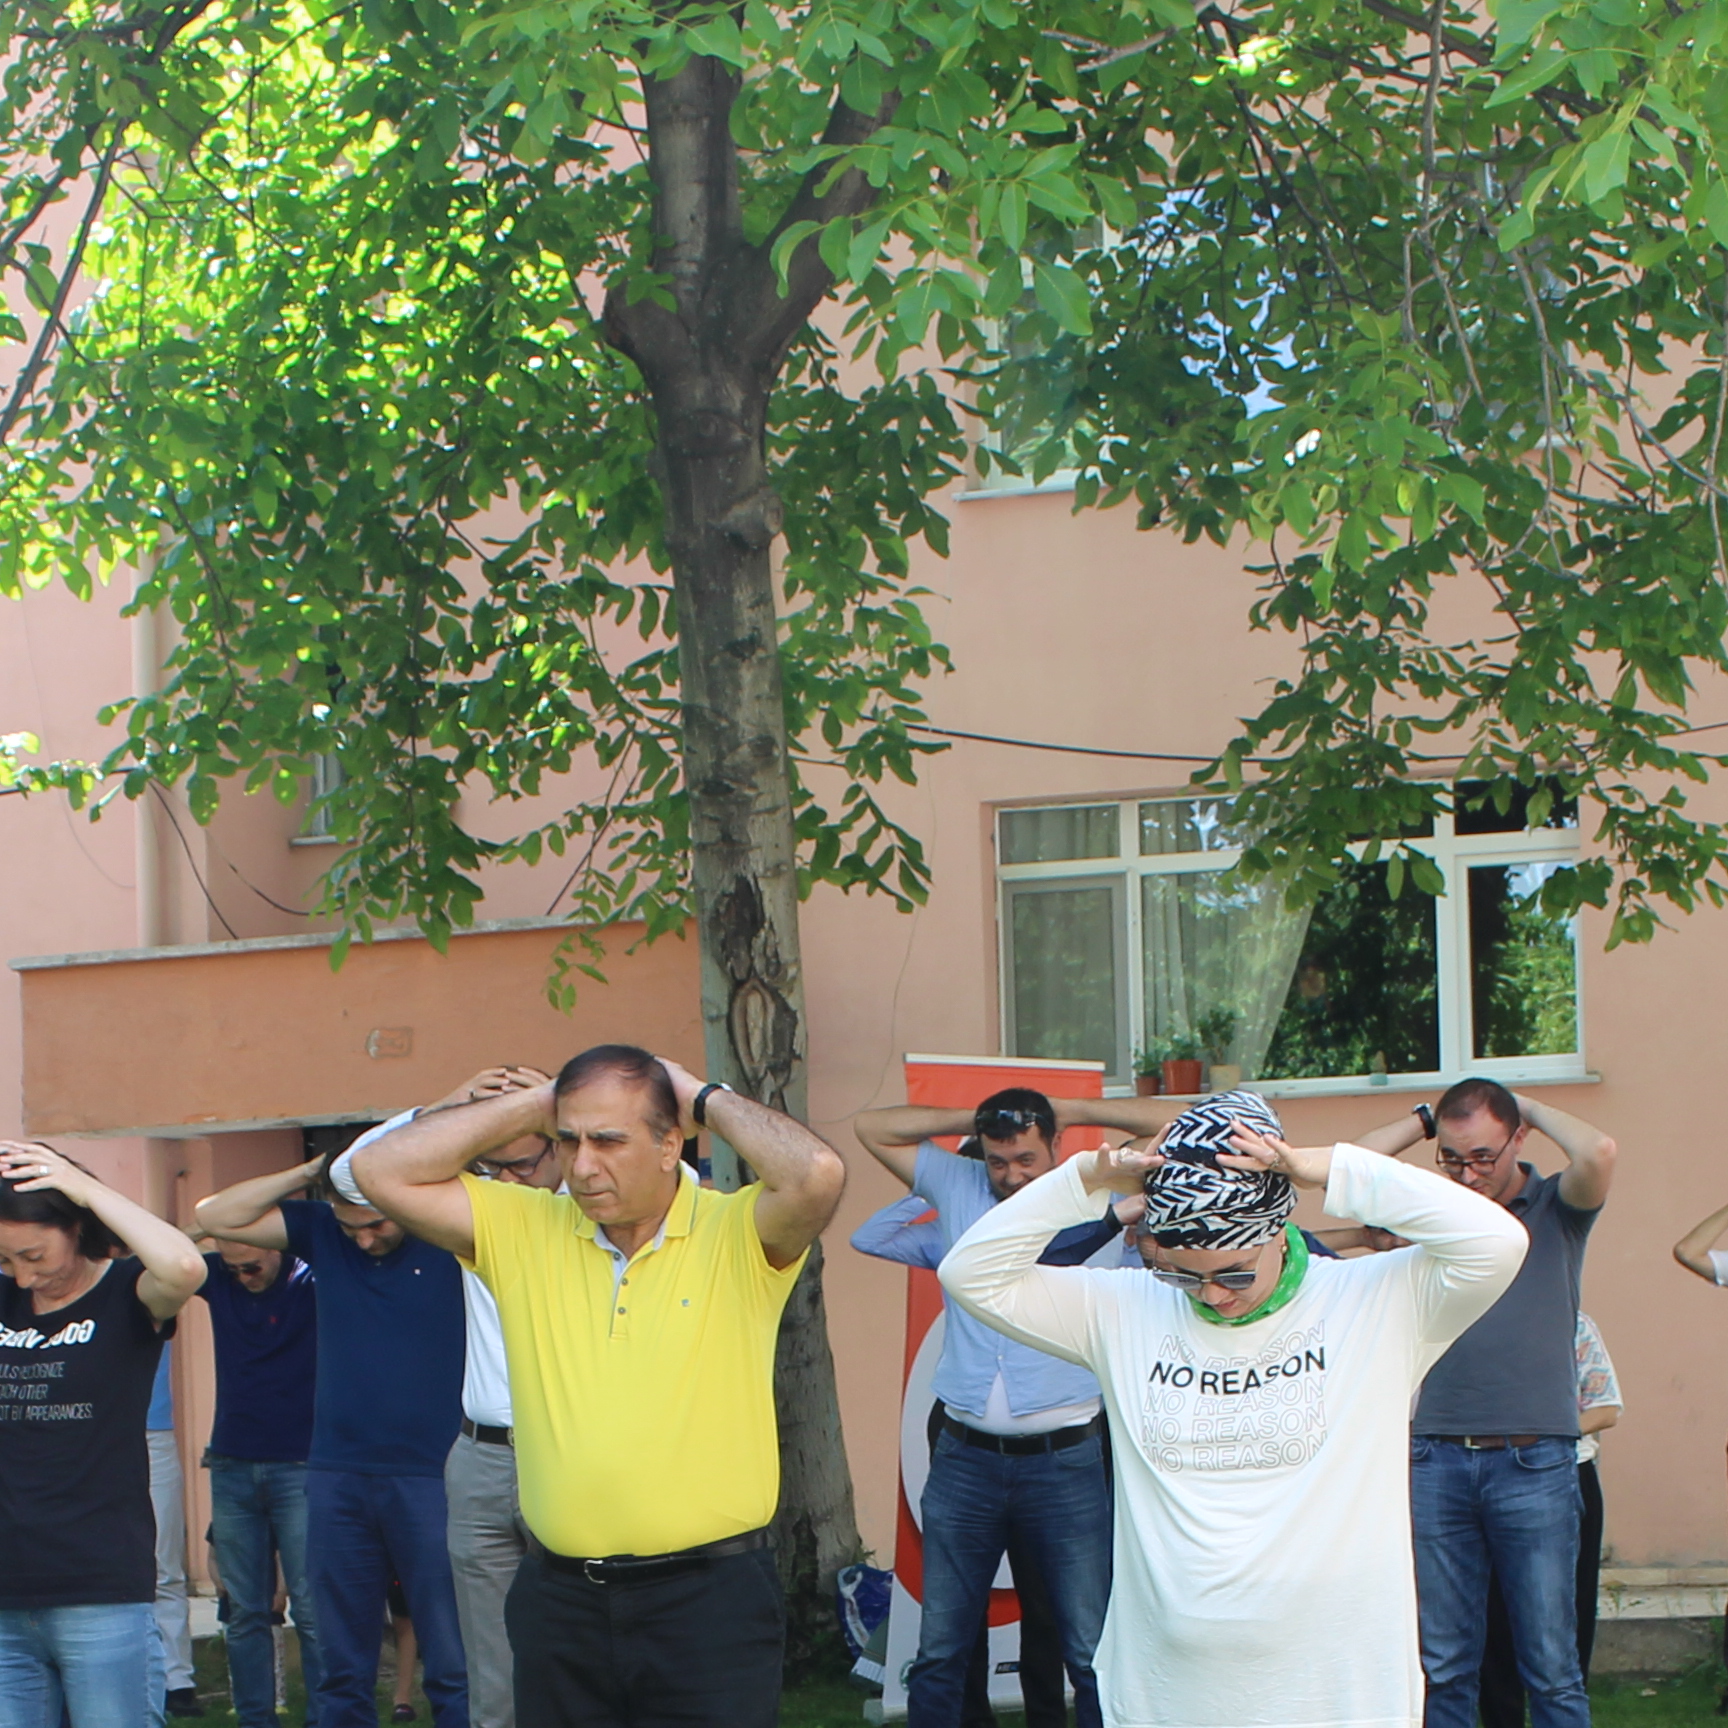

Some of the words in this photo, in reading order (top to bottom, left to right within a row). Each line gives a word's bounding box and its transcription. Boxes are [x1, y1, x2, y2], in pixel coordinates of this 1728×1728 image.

[18, 1383, 49, 1400] OTHER
[1149, 1360, 1194, 1388] NO
[1200, 1346, 1326, 1396] REASON
[12, 1405, 23, 1420] BY
[1144, 1386, 1186, 1415] NO
[1193, 1375, 1326, 1416] REASON
[1142, 1416, 1182, 1445] NO
[1191, 1401, 1327, 1444] REASON
[1142, 1445, 1184, 1473] NO
[1193, 1430, 1328, 1472] REASON
